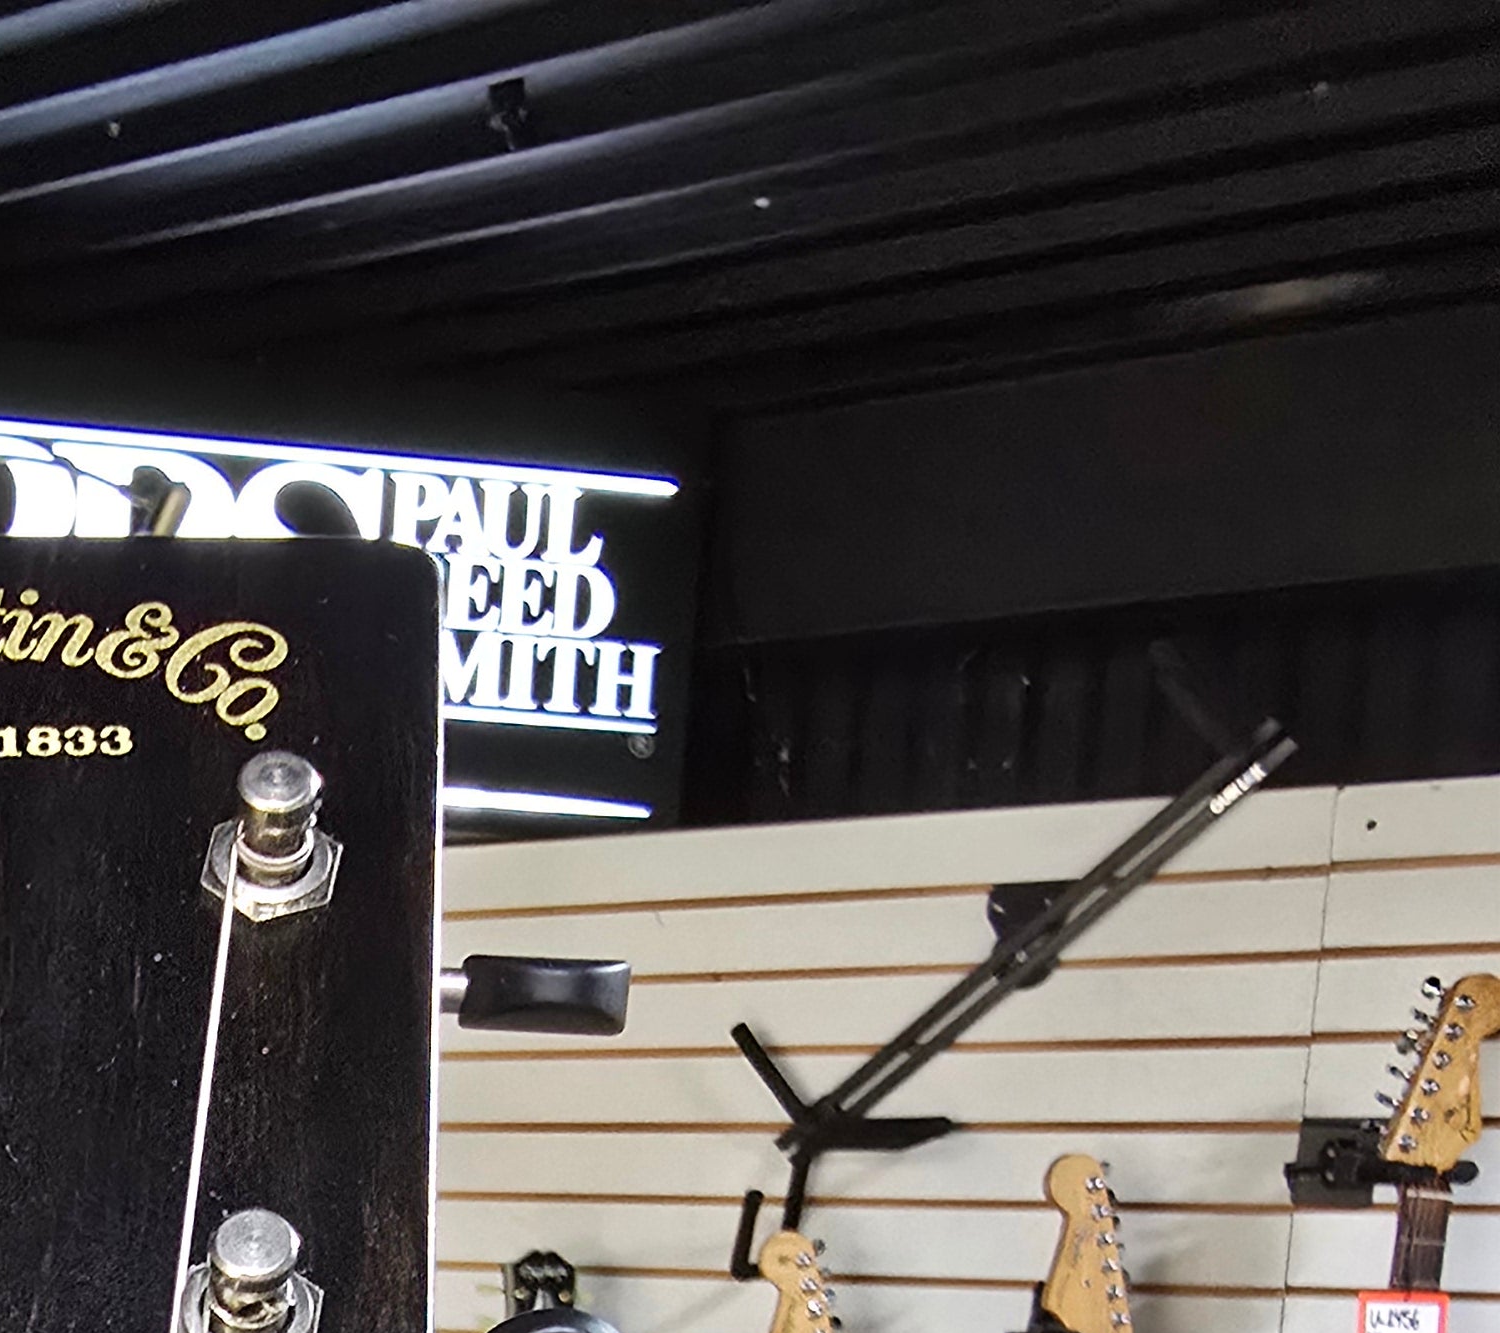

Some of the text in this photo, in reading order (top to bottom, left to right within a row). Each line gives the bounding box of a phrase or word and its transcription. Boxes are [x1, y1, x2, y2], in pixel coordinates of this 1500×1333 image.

[389, 472, 604, 567] PAUL
[440, 554, 617, 640] EED
[441, 630, 664, 719] MITH
